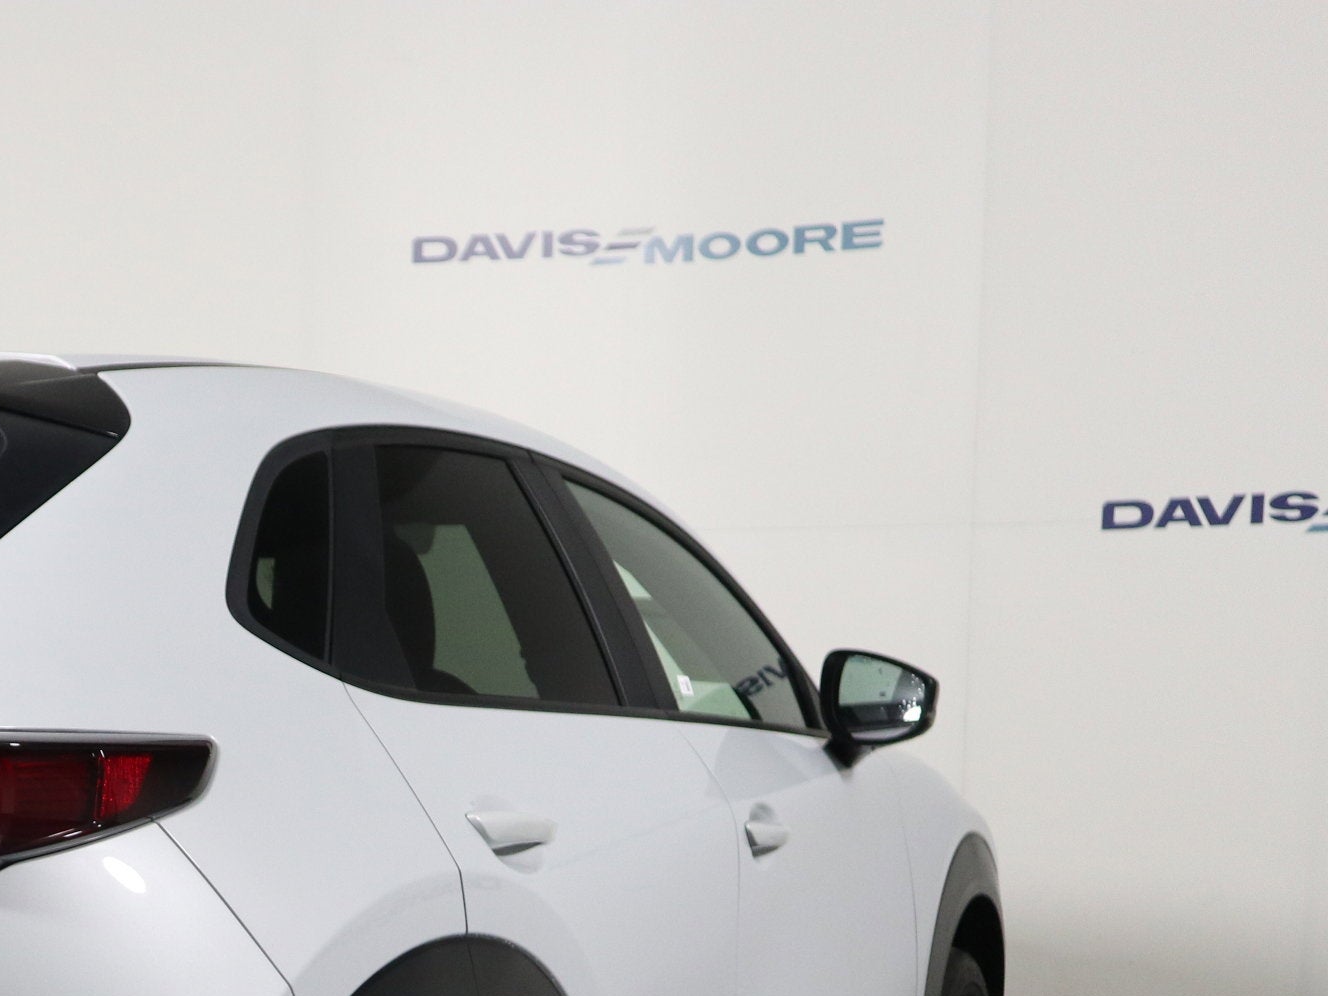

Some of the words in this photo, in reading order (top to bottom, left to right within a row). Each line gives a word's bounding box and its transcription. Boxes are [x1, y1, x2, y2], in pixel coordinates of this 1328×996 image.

[411, 229, 601, 265] DAVIS
[643, 218, 885, 265] MOORE
[1101, 490, 1319, 531] DAVIS
